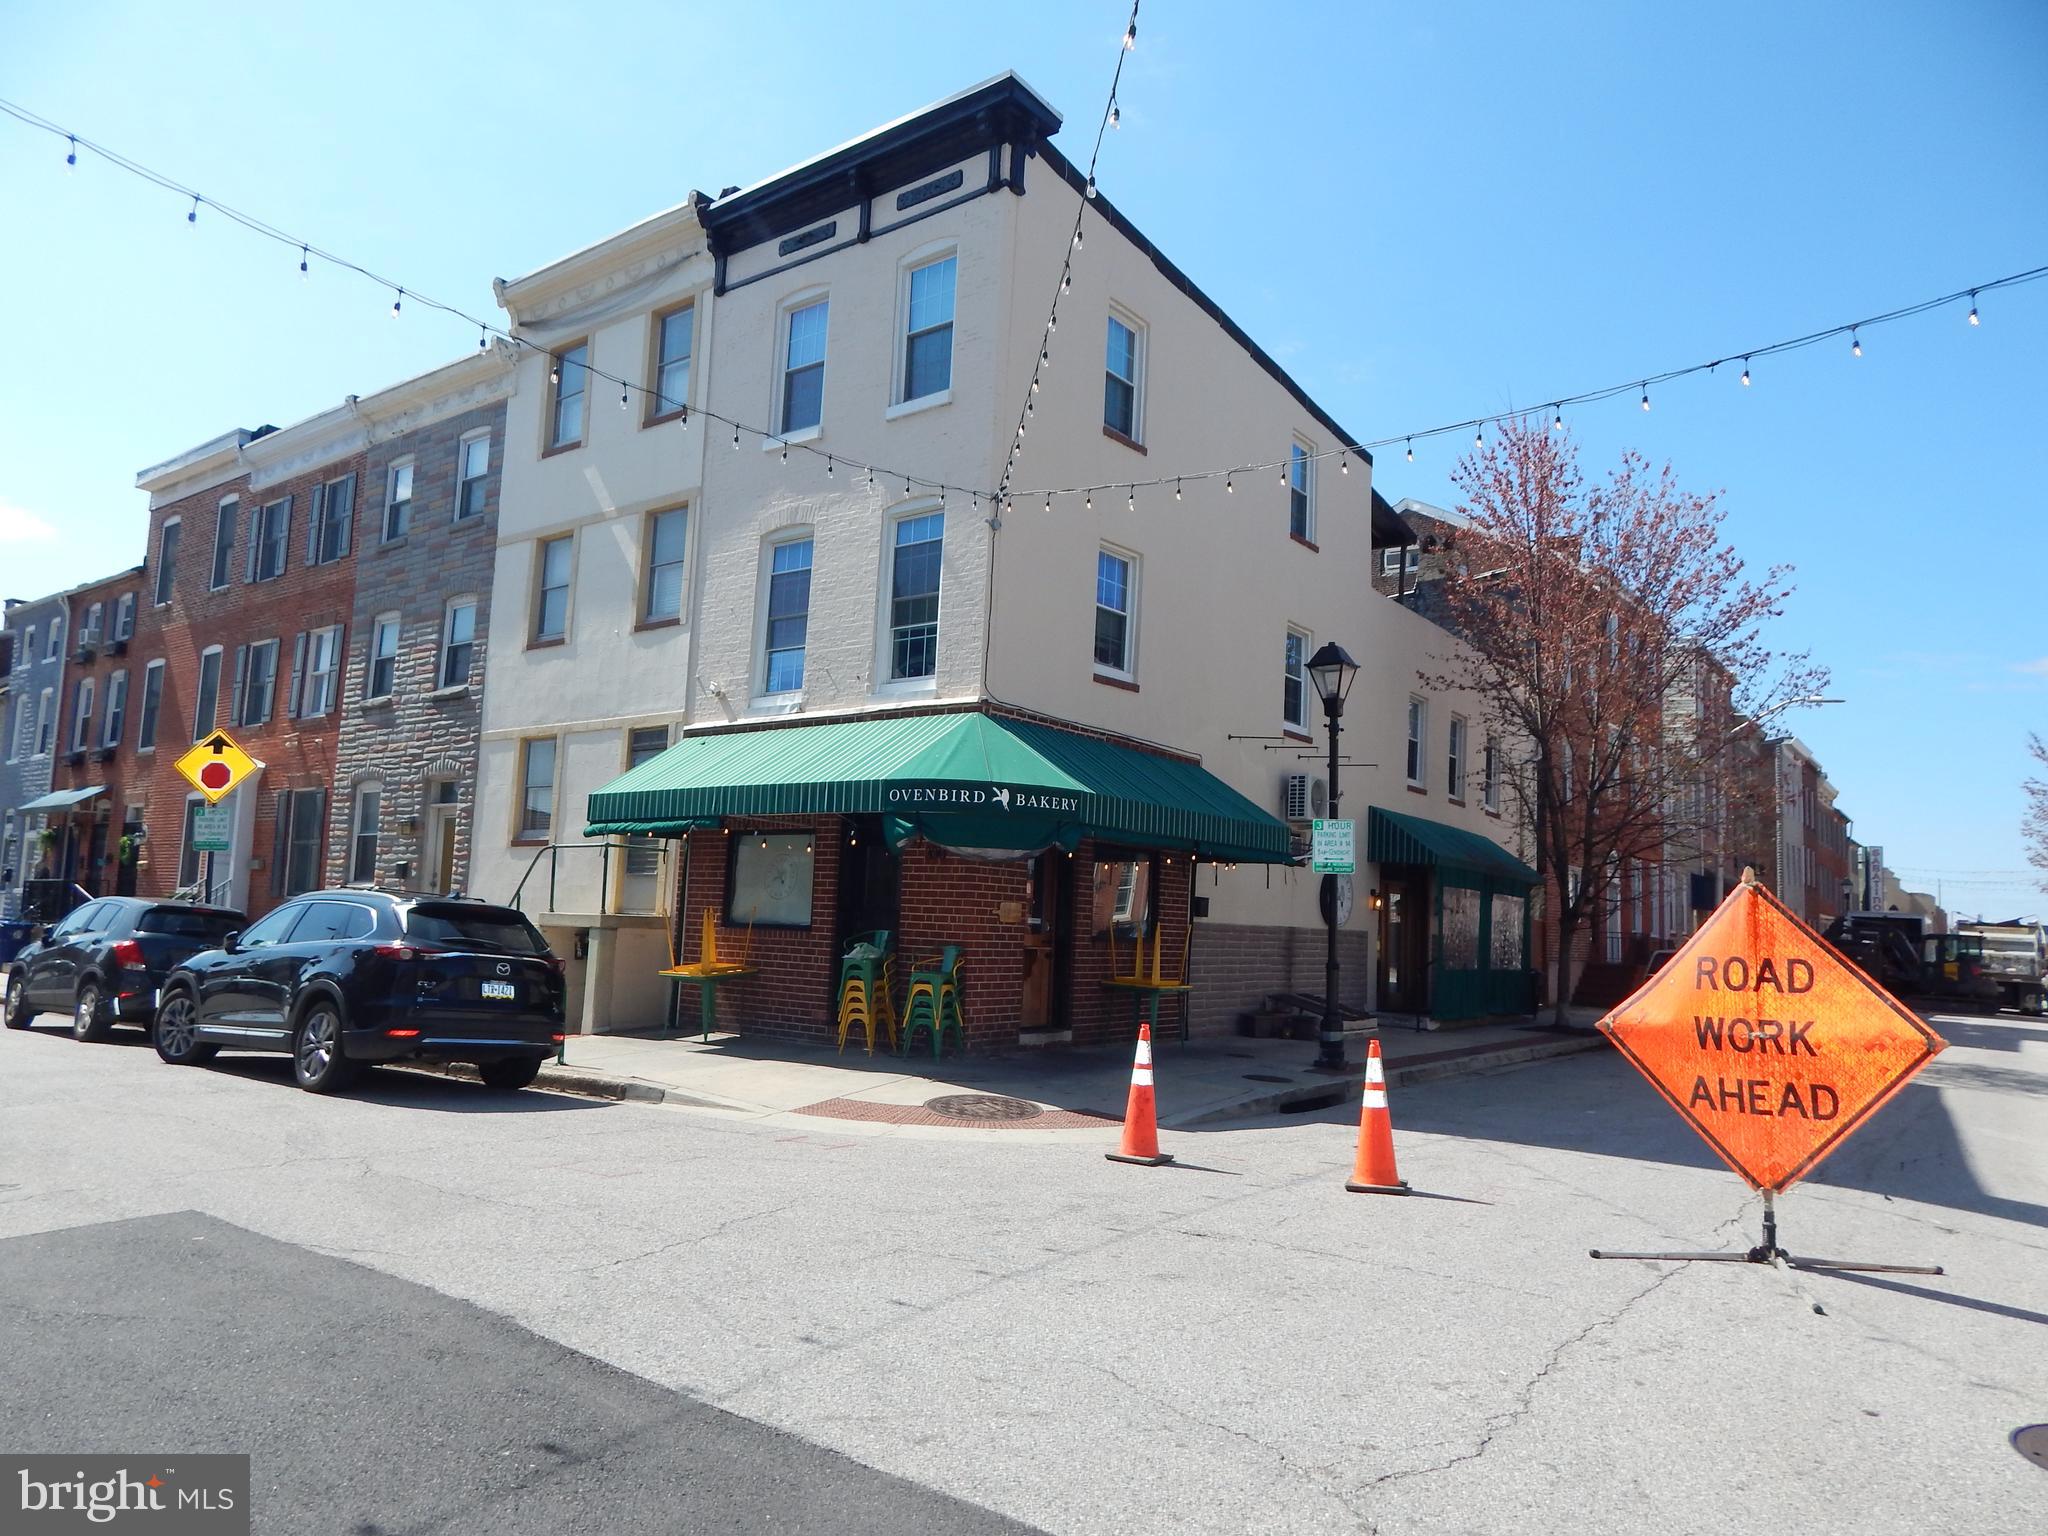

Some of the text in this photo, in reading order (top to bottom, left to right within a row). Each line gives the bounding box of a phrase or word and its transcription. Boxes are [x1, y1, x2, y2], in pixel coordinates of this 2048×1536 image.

[889, 788, 1078, 811] OVENBIRD BAKERY
[1316, 821, 1352, 830] 3 HOUR
[1695, 956, 1815, 994] ROAD
[1693, 1015, 1818, 1057] WORK
[1689, 1075, 1840, 1122] AHEAD
